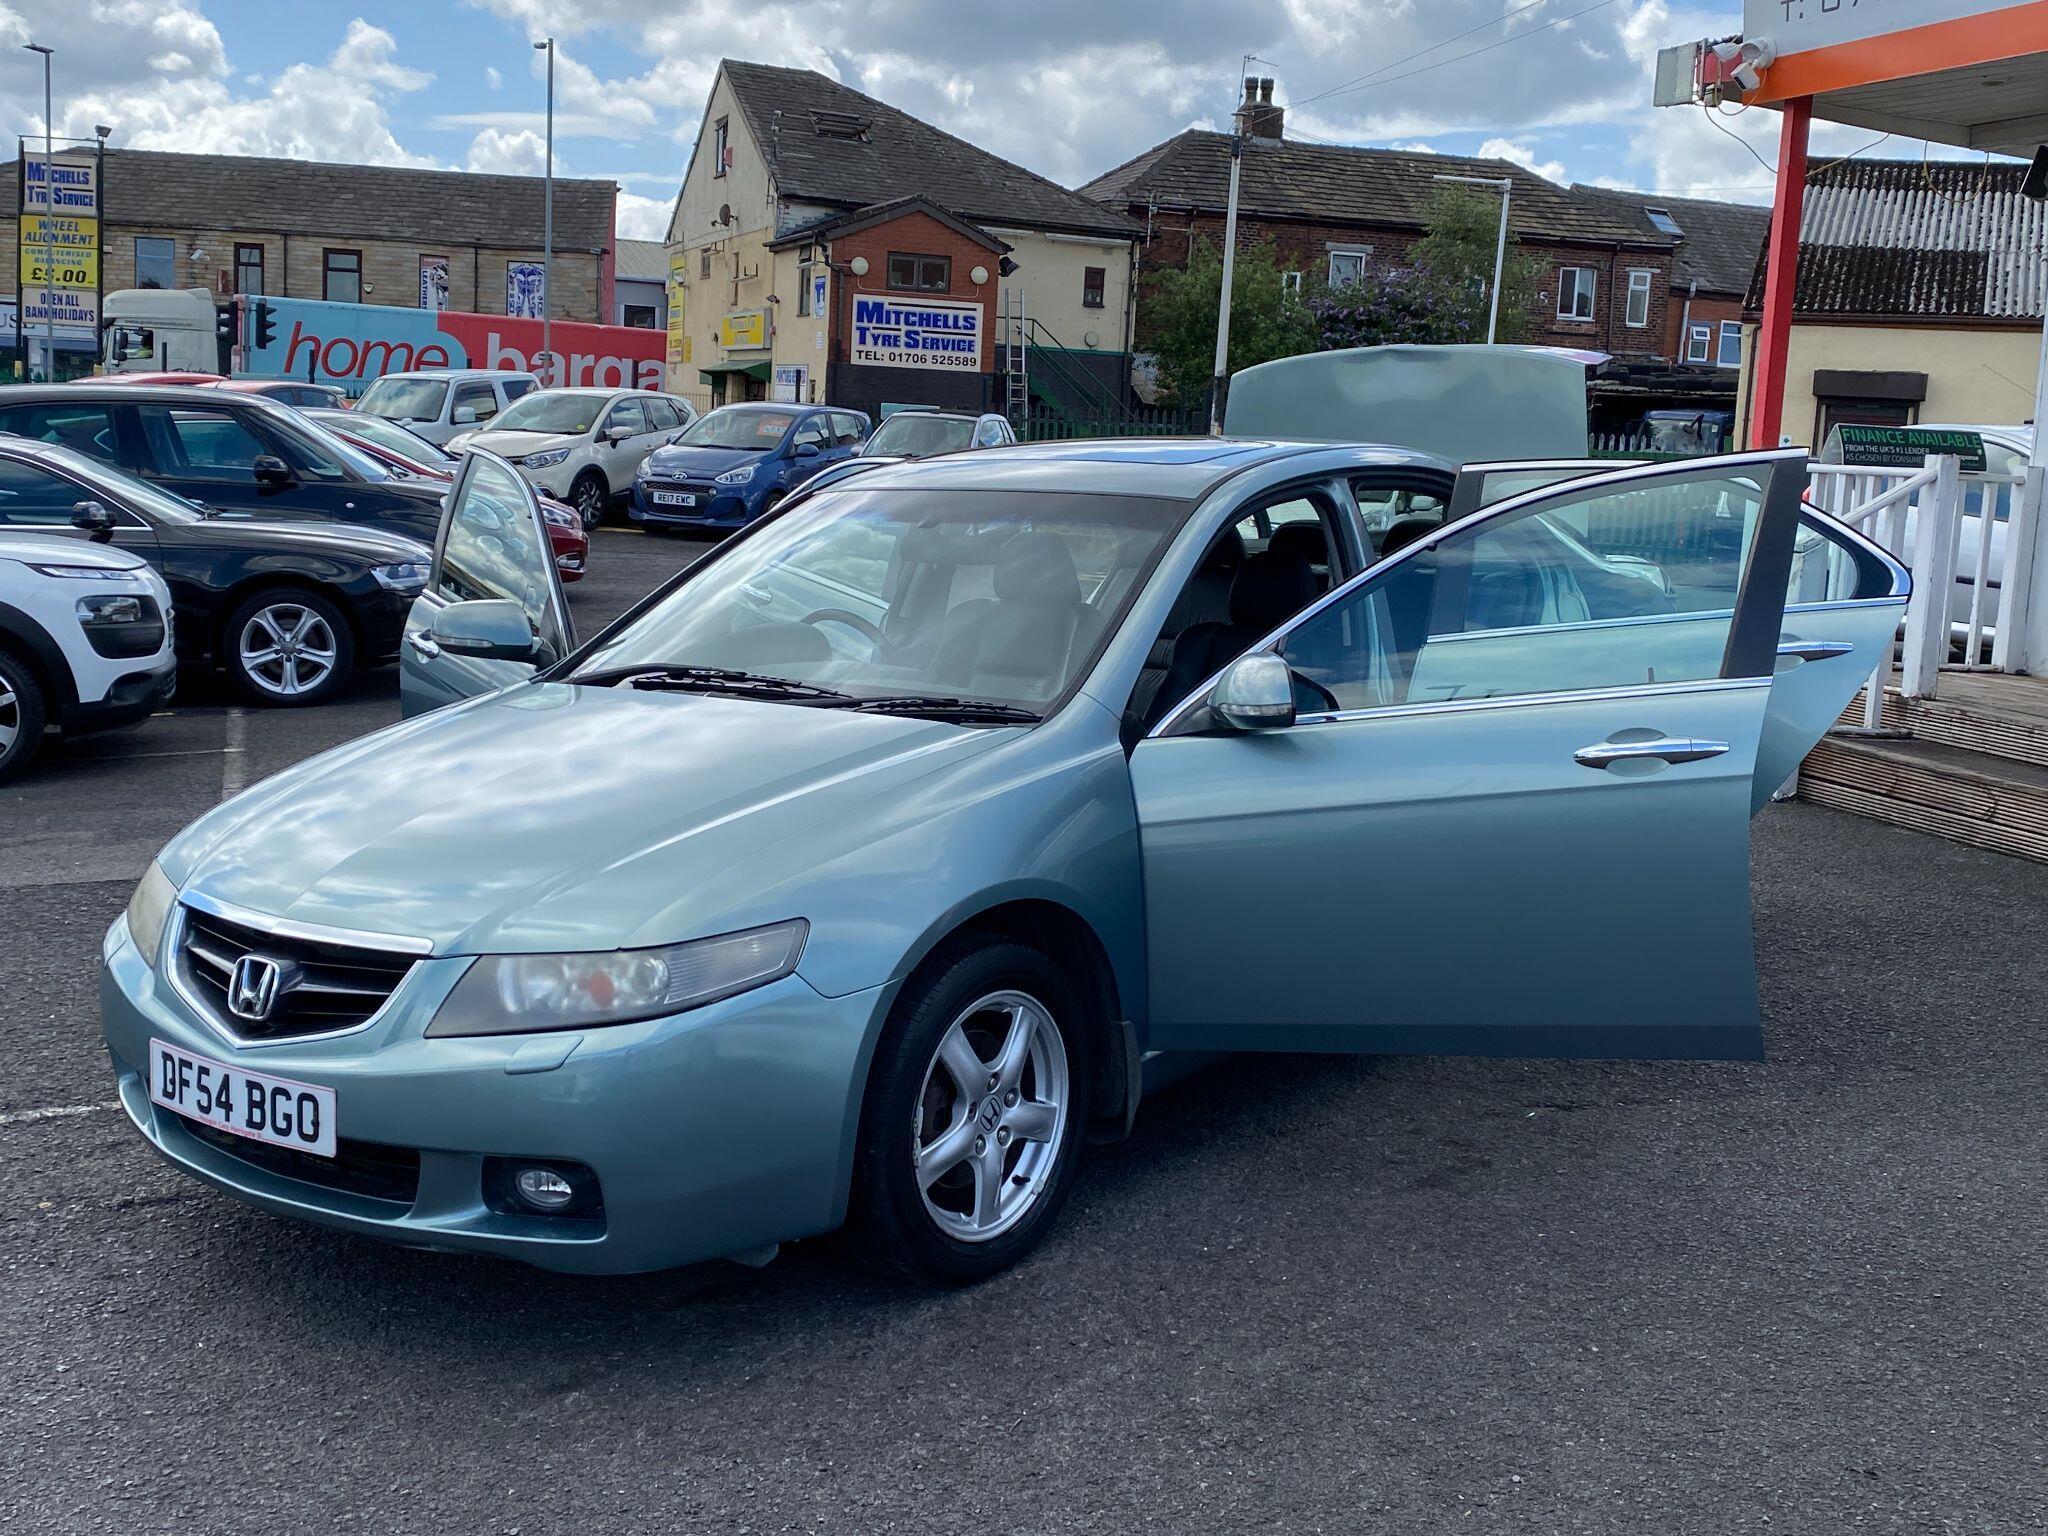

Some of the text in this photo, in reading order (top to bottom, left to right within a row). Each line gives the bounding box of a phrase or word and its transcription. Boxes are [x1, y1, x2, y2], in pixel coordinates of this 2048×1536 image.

[27, 162, 90, 184] MICHELLS
[27, 185, 94, 207] TYR SERVICE
[38, 219, 79, 232] WHEEL
[31, 267, 87, 283] £5.00
[41, 292, 79, 307] OEN ALL
[52, 308, 95, 321] HOLIDAYS
[856, 301, 977, 331] MITCHELLS
[284, 320, 449, 378] home
[856, 326, 975, 353] TYRE SERVICE
[856, 350, 977, 367] TEL: 01706 525589
[1842, 428, 1982, 449] FINANCE AVAILABLE
[1845, 444, 1865, 452] FROM
[1866, 445, 1879, 453] THE
[162, 1050, 320, 1143] DF54 BGO
